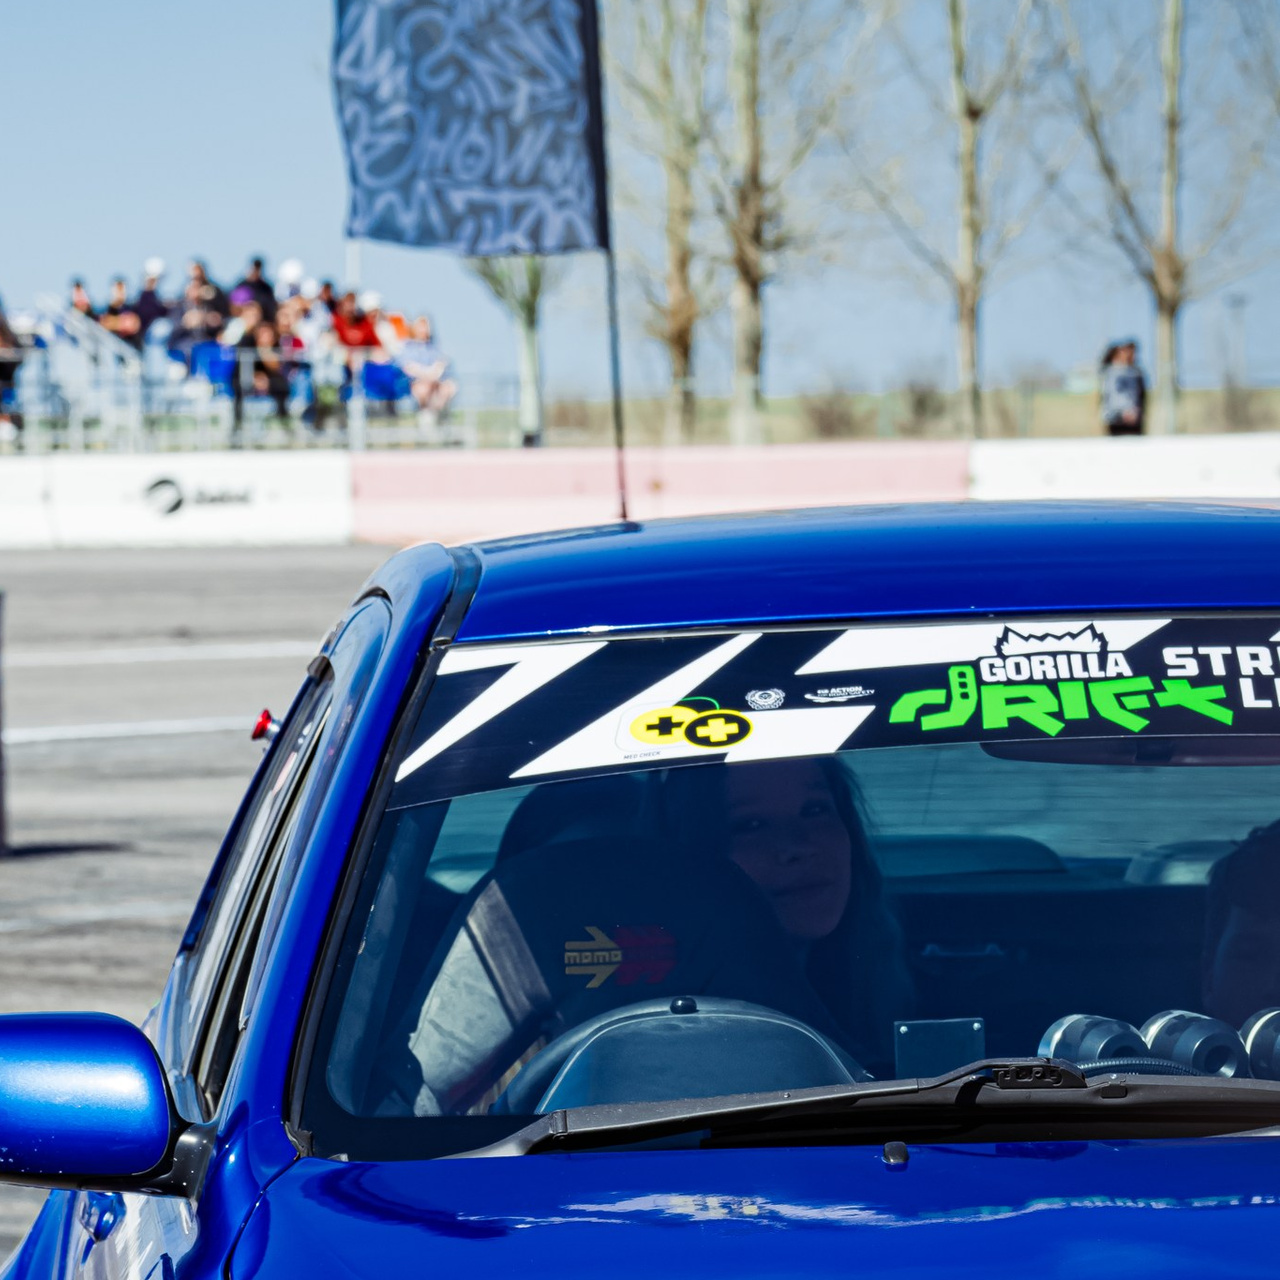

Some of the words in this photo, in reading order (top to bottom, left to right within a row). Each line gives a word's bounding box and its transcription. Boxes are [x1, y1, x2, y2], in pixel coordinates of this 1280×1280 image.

[979, 652, 1133, 683] GORILLA
[1162, 646, 1280, 677] STR
[830, 686, 862, 694] ACTION
[889, 665, 1234, 737] DRIFT
